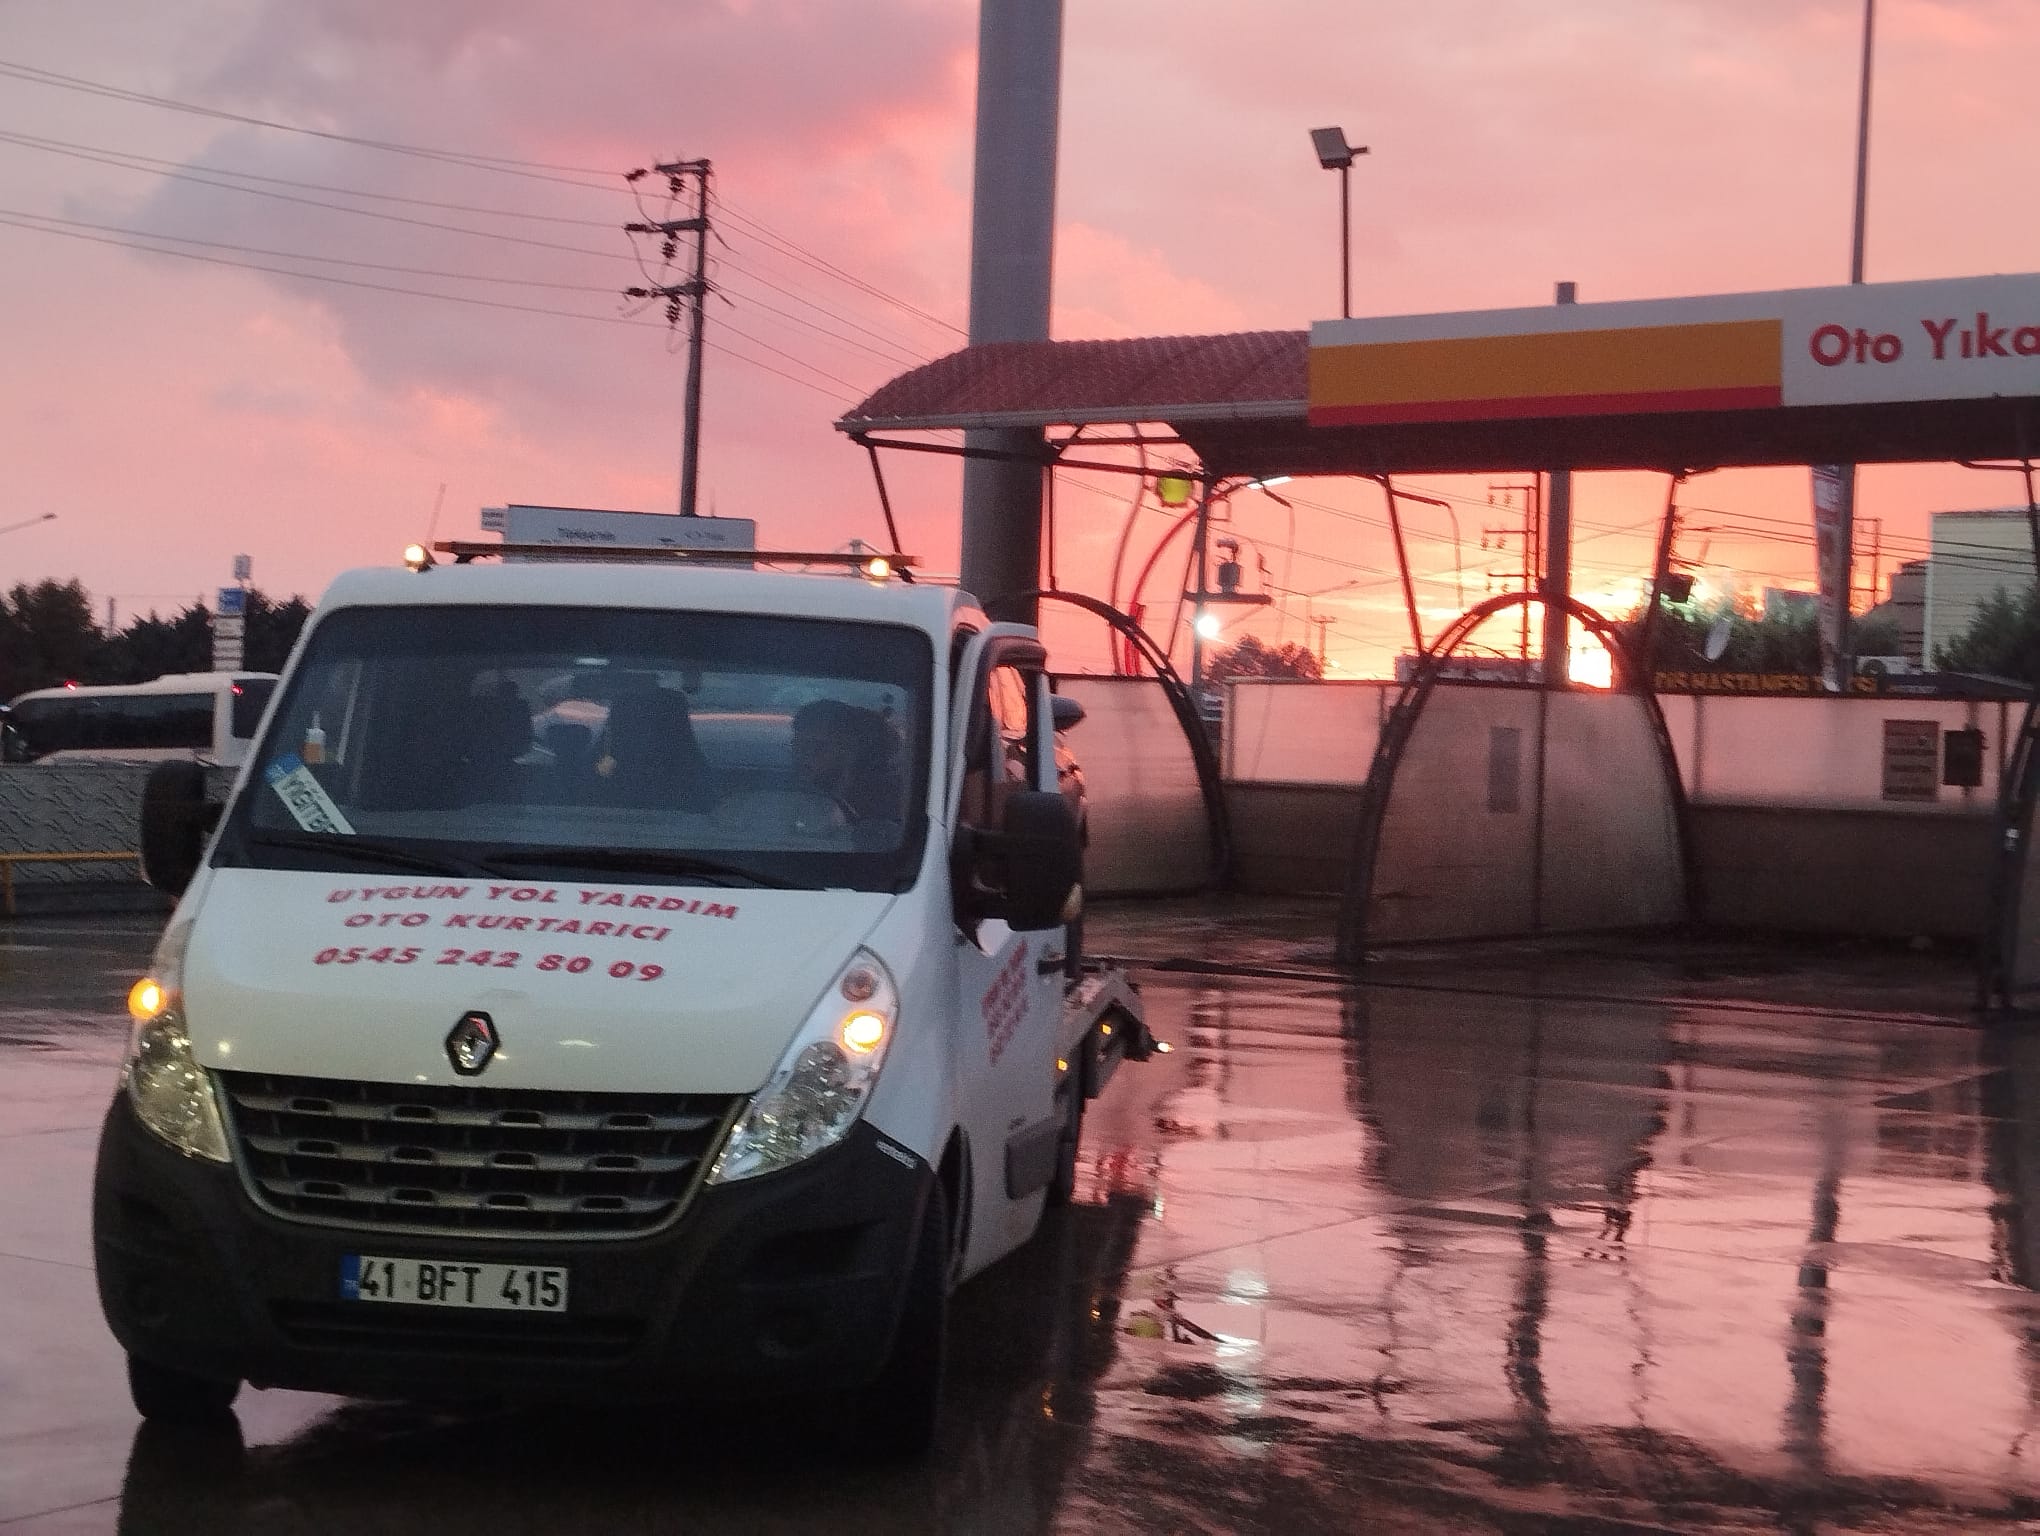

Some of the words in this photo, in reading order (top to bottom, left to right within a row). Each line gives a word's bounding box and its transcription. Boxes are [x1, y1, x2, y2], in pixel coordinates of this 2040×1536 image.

[1809, 323, 1904, 367] Oto
[325, 885, 473, 903] UYGUN
[486, 885, 560, 903] YOL
[577, 890, 740, 920] YARDIM
[343, 912, 431, 929] OTO
[442, 913, 674, 942] KURTARICI
[312, 946, 425, 966] 0545
[435, 947, 522, 969] 242
[534, 953, 593, 975] 80
[607, 960, 667, 982] 09
[360, 1259, 396, 1299] 41
[417, 1263, 481, 1304] BFT
[500, 1268, 561, 1308] 415
